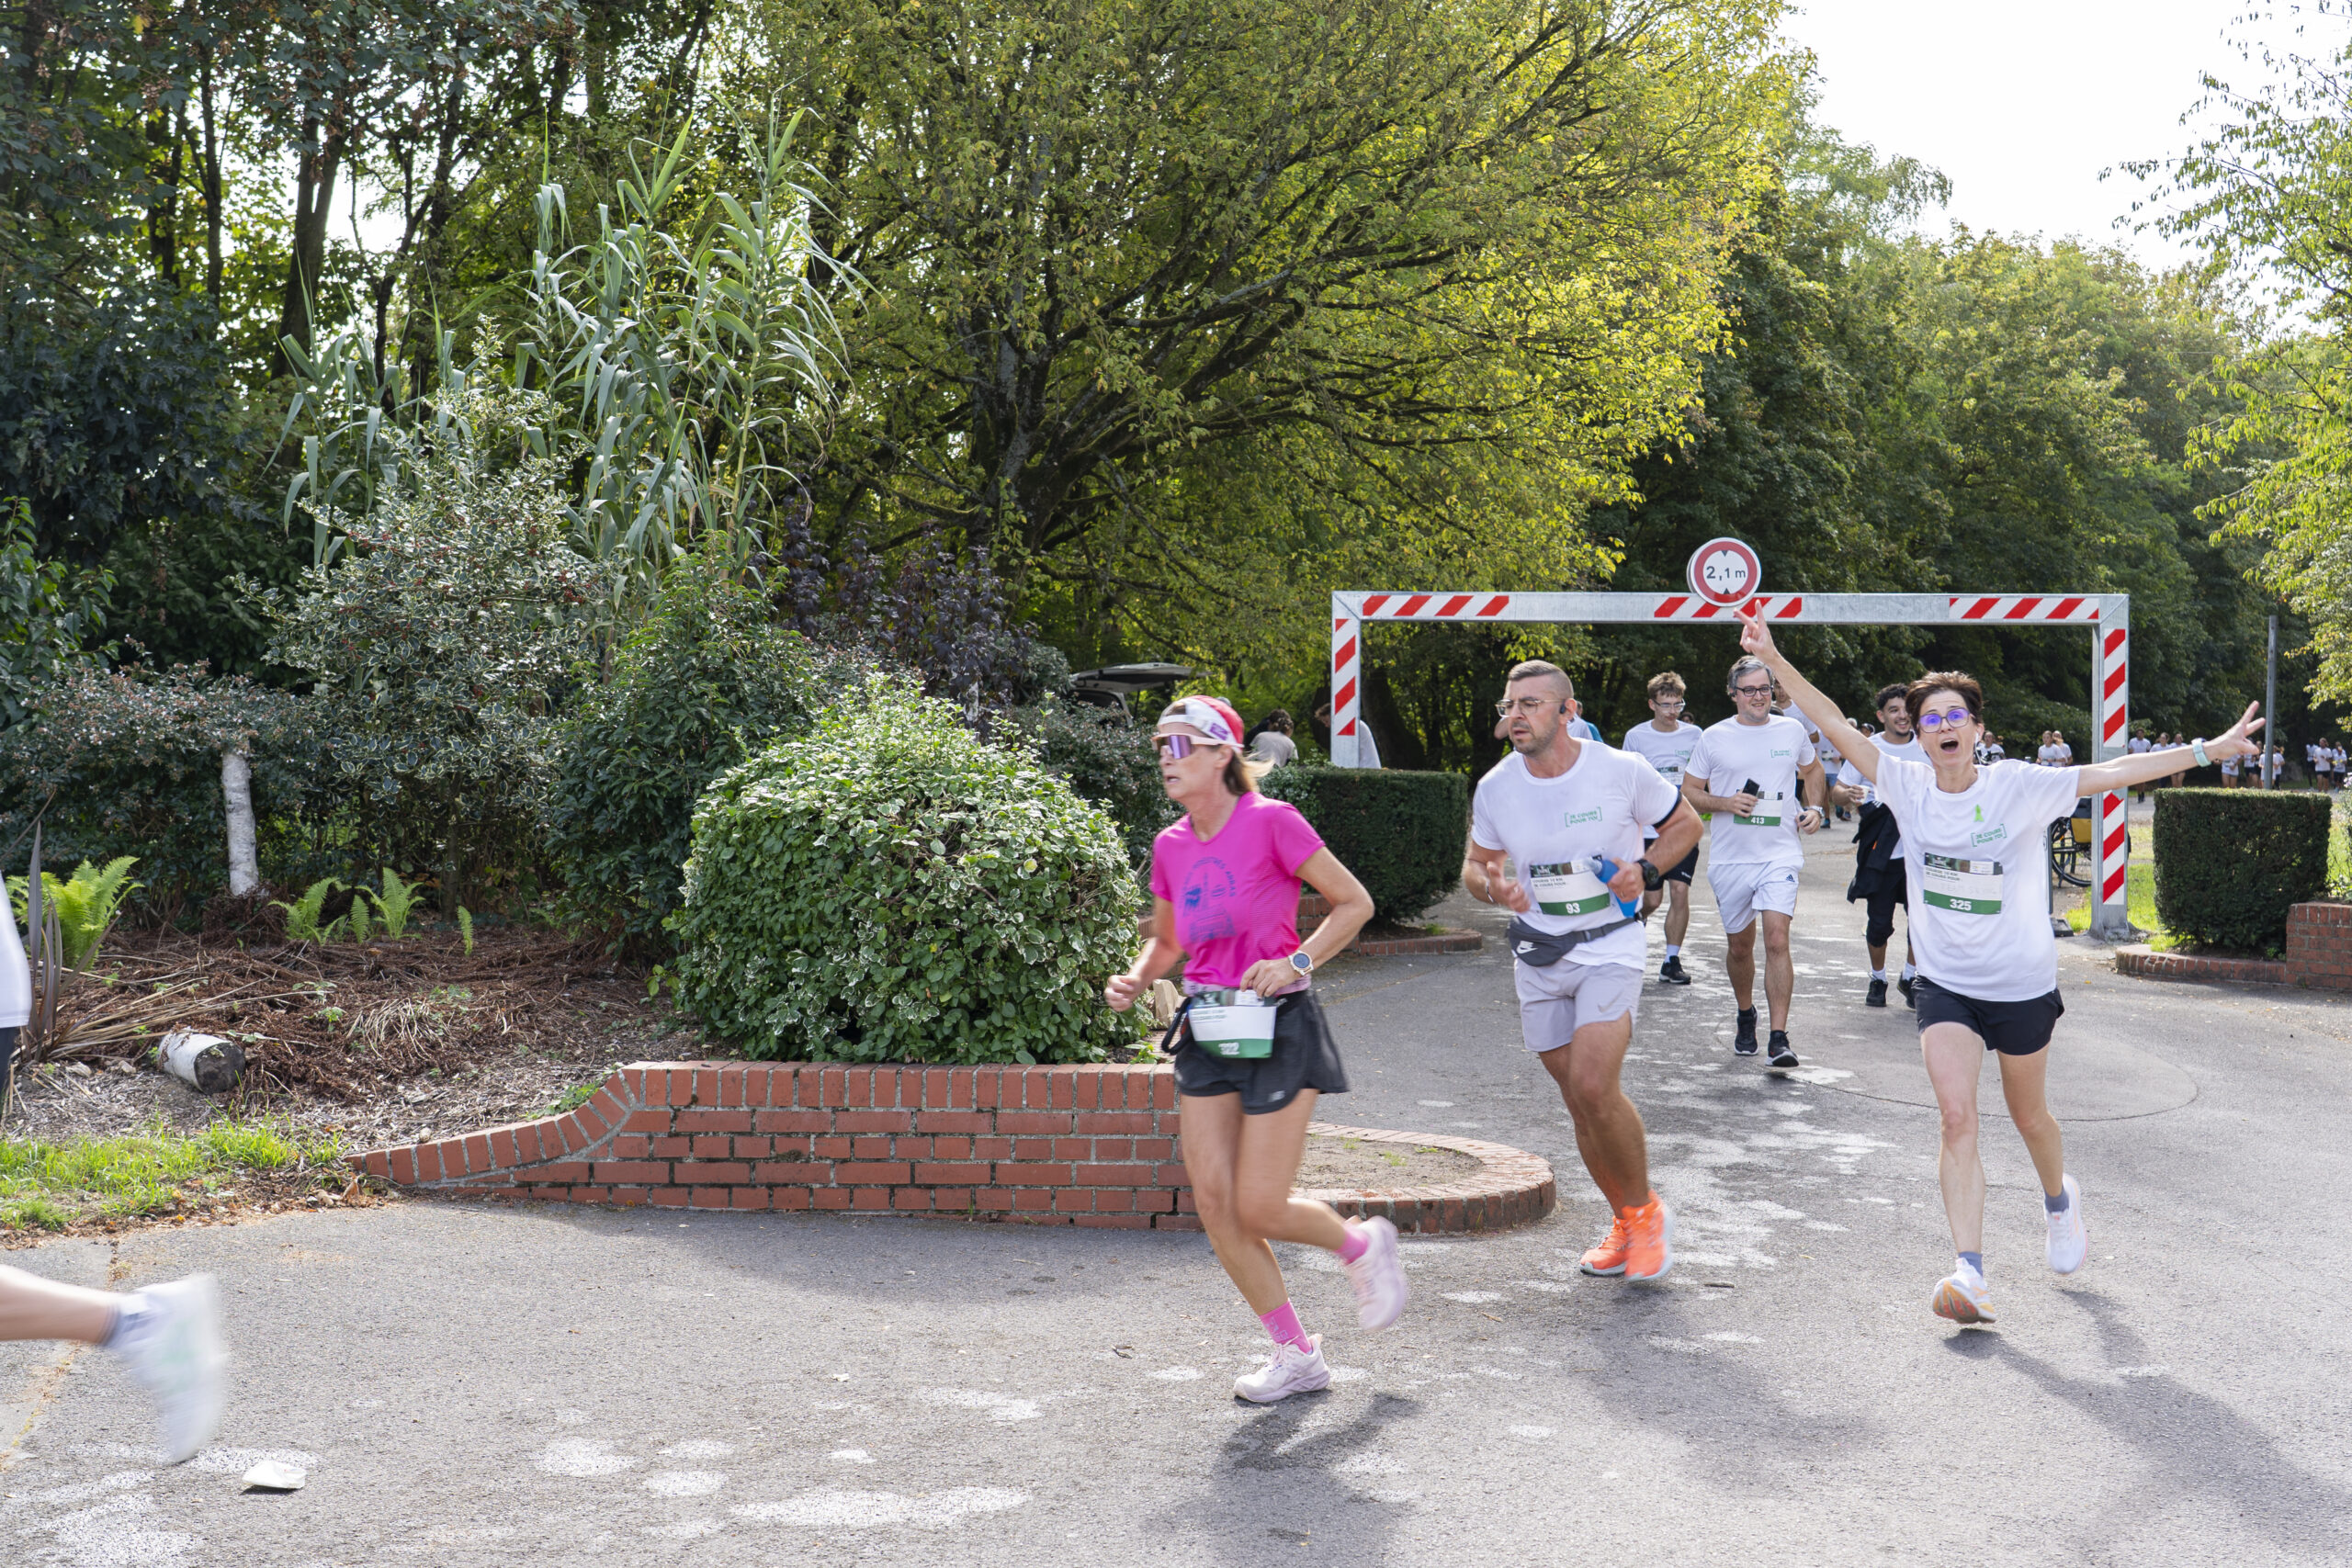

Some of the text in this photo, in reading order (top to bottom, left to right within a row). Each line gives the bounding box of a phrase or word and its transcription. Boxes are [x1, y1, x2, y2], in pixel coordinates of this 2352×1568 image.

[1706, 566, 1746, 581] 2,1 m
[1566, 903, 1581, 914] 93
[1950, 898, 1972, 911] 325
